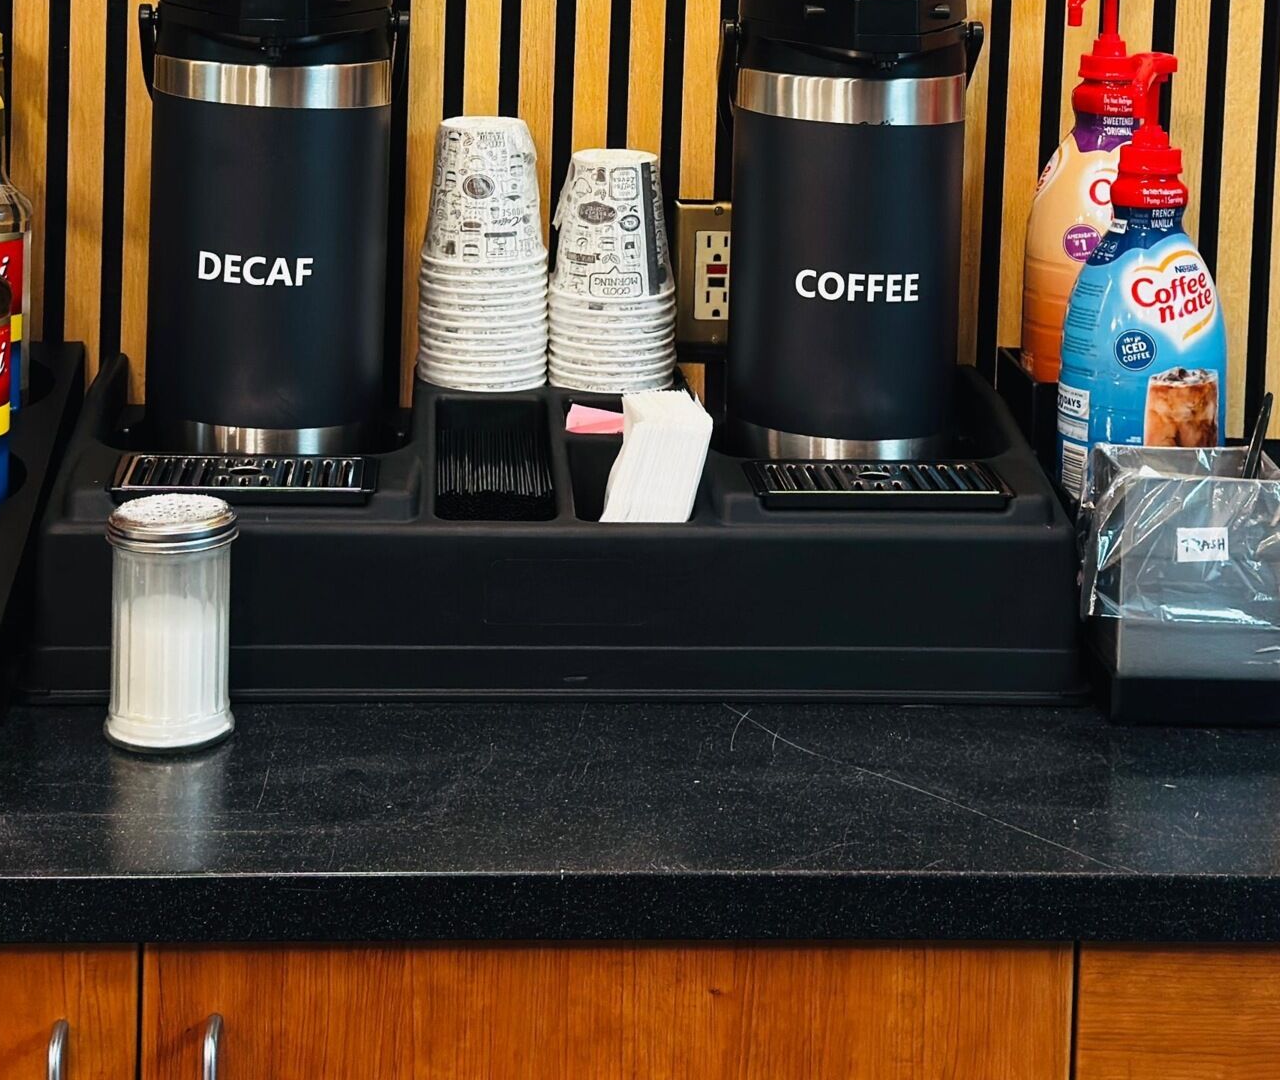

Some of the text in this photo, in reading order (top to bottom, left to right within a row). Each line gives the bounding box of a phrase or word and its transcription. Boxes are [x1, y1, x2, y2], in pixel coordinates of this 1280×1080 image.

[1152, 208, 1176, 218] FRENCH
[198, 250, 314, 287] DECAF
[594, 277, 638, 286] MORNING
[795, 269, 920, 302] COFFEE
[603, 287, 630, 295] GOOD
[1131, 272, 1207, 308] Coffee
[1122, 341, 1147, 355] ICED
[1123, 351, 1151, 363] COFFEE
